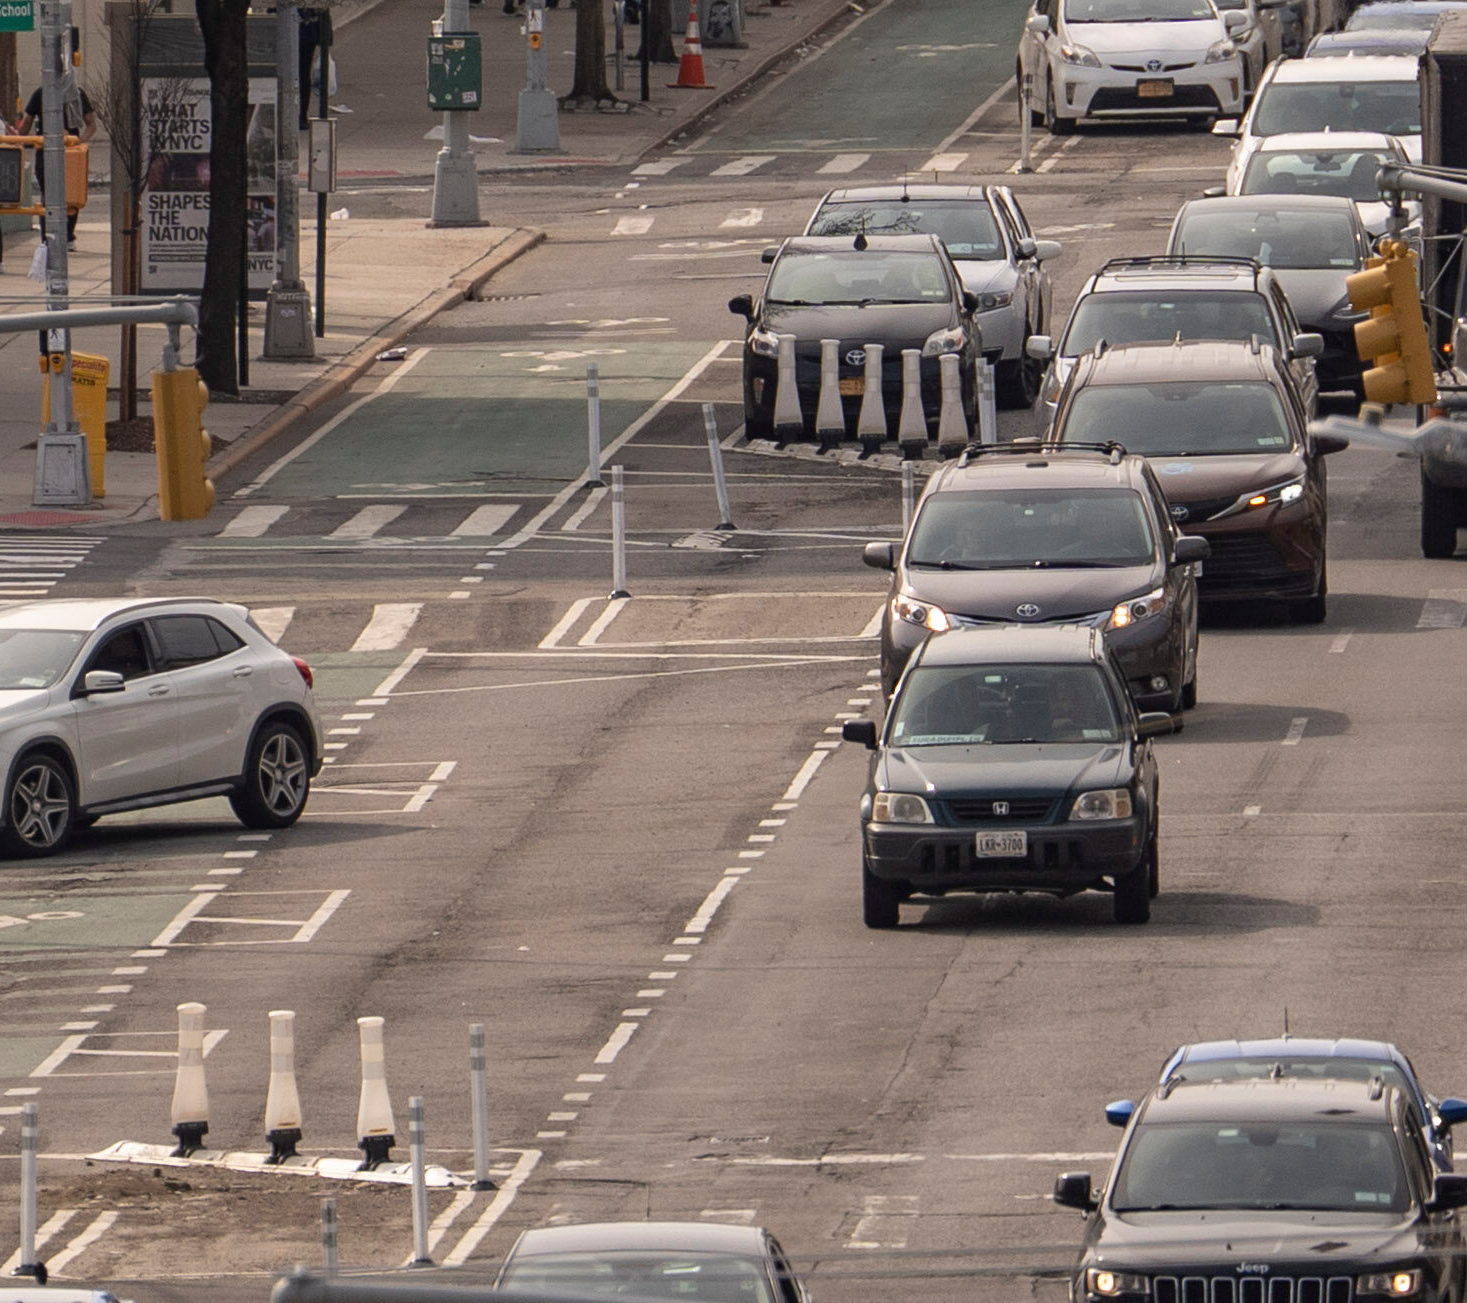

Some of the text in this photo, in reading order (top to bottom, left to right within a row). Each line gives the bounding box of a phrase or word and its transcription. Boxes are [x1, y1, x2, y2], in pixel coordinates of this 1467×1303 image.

[148, 103, 198, 119] WHAT
[148, 119, 210, 134] STARTS
[169, 135, 203, 151] NYC
[148, 194, 211, 211] SHAPES
[148, 210, 181, 226] THE
[148, 226, 209, 242] NATION
[247, 258, 274, 271] NYC
[1236, 1261, 1270, 1275] Jeep
